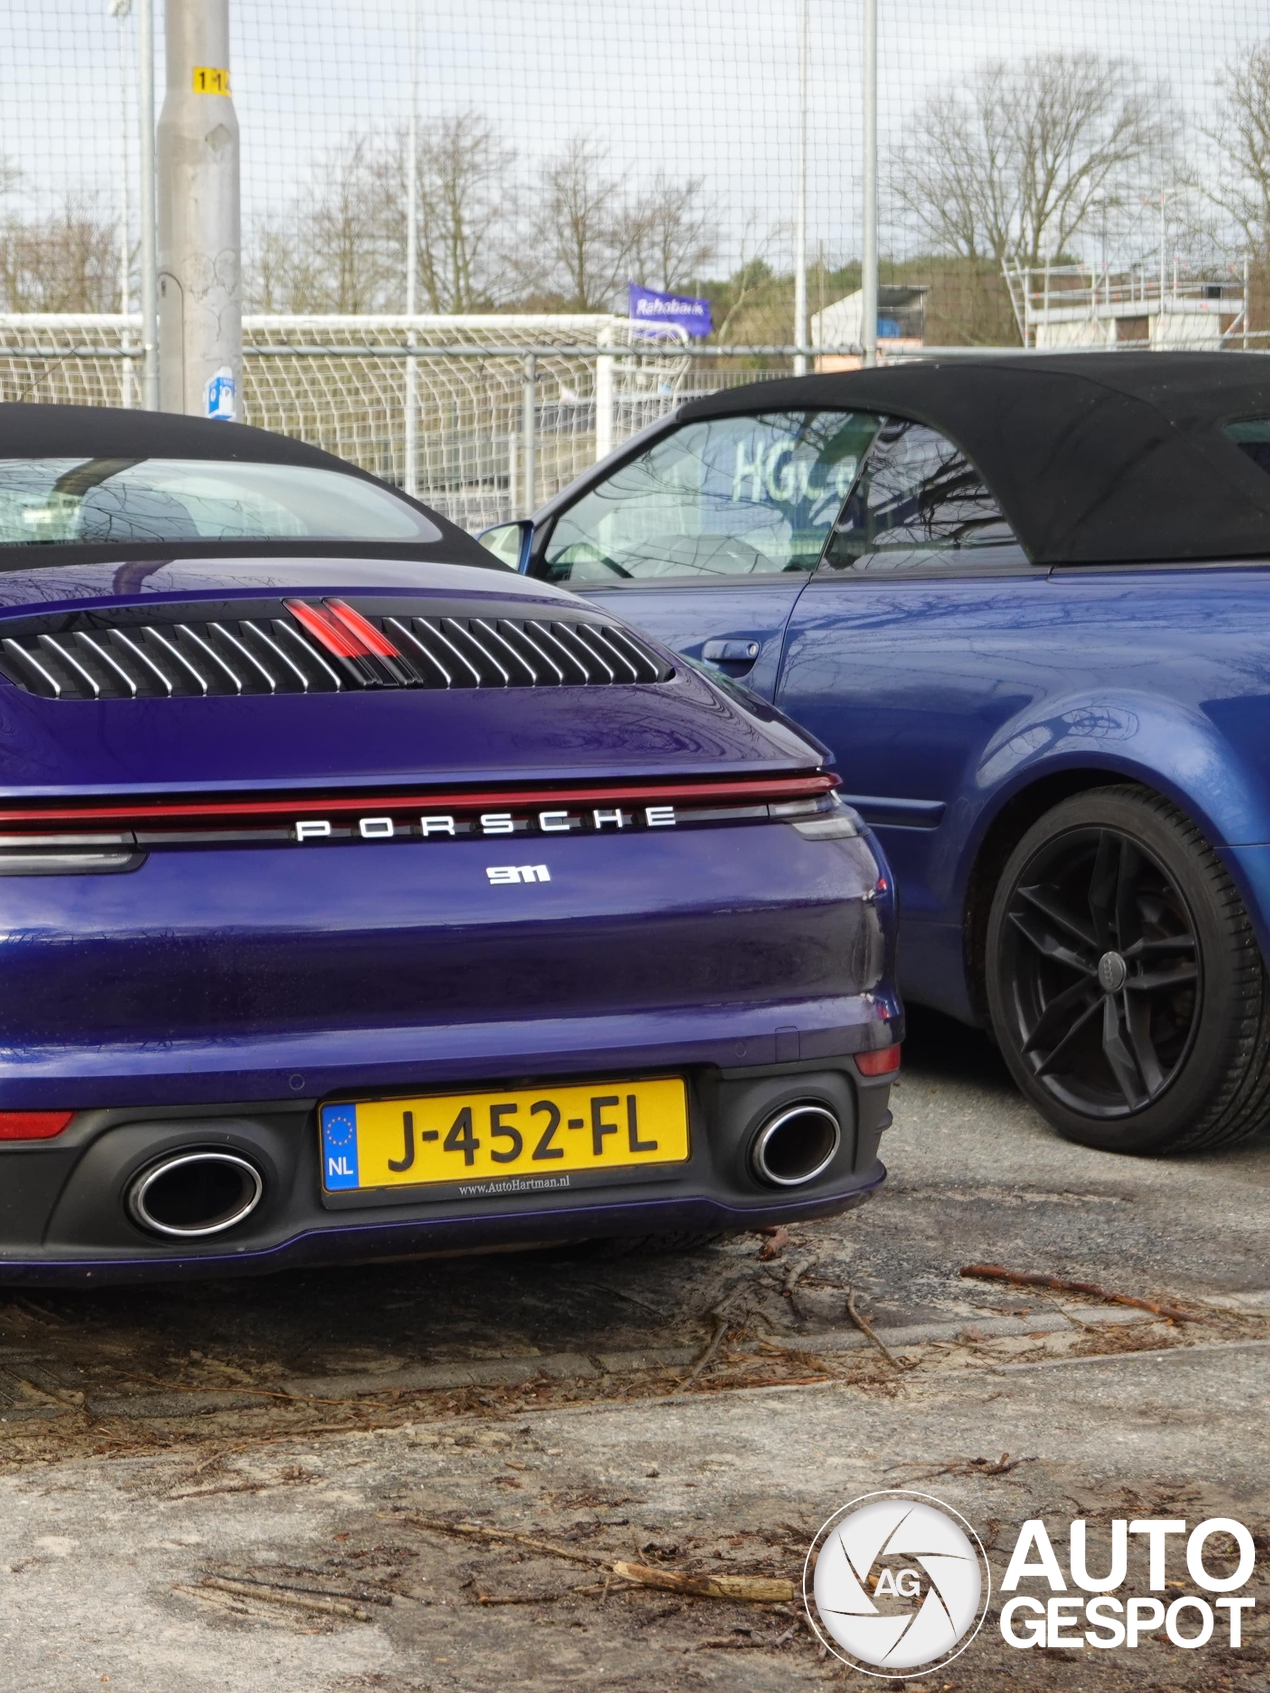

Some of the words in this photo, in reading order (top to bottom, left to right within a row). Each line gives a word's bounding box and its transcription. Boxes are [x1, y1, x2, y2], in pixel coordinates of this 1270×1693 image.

[636, 298, 705, 317] Rabobank
[295, 806, 677, 842] PORSCHE
[486, 864, 552, 885] 911
[387, 1094, 659, 1173] J-452-FL
[328, 1156, 354, 1177] NL
[458, 1175, 571, 1196] www.AutoHartman.nl
